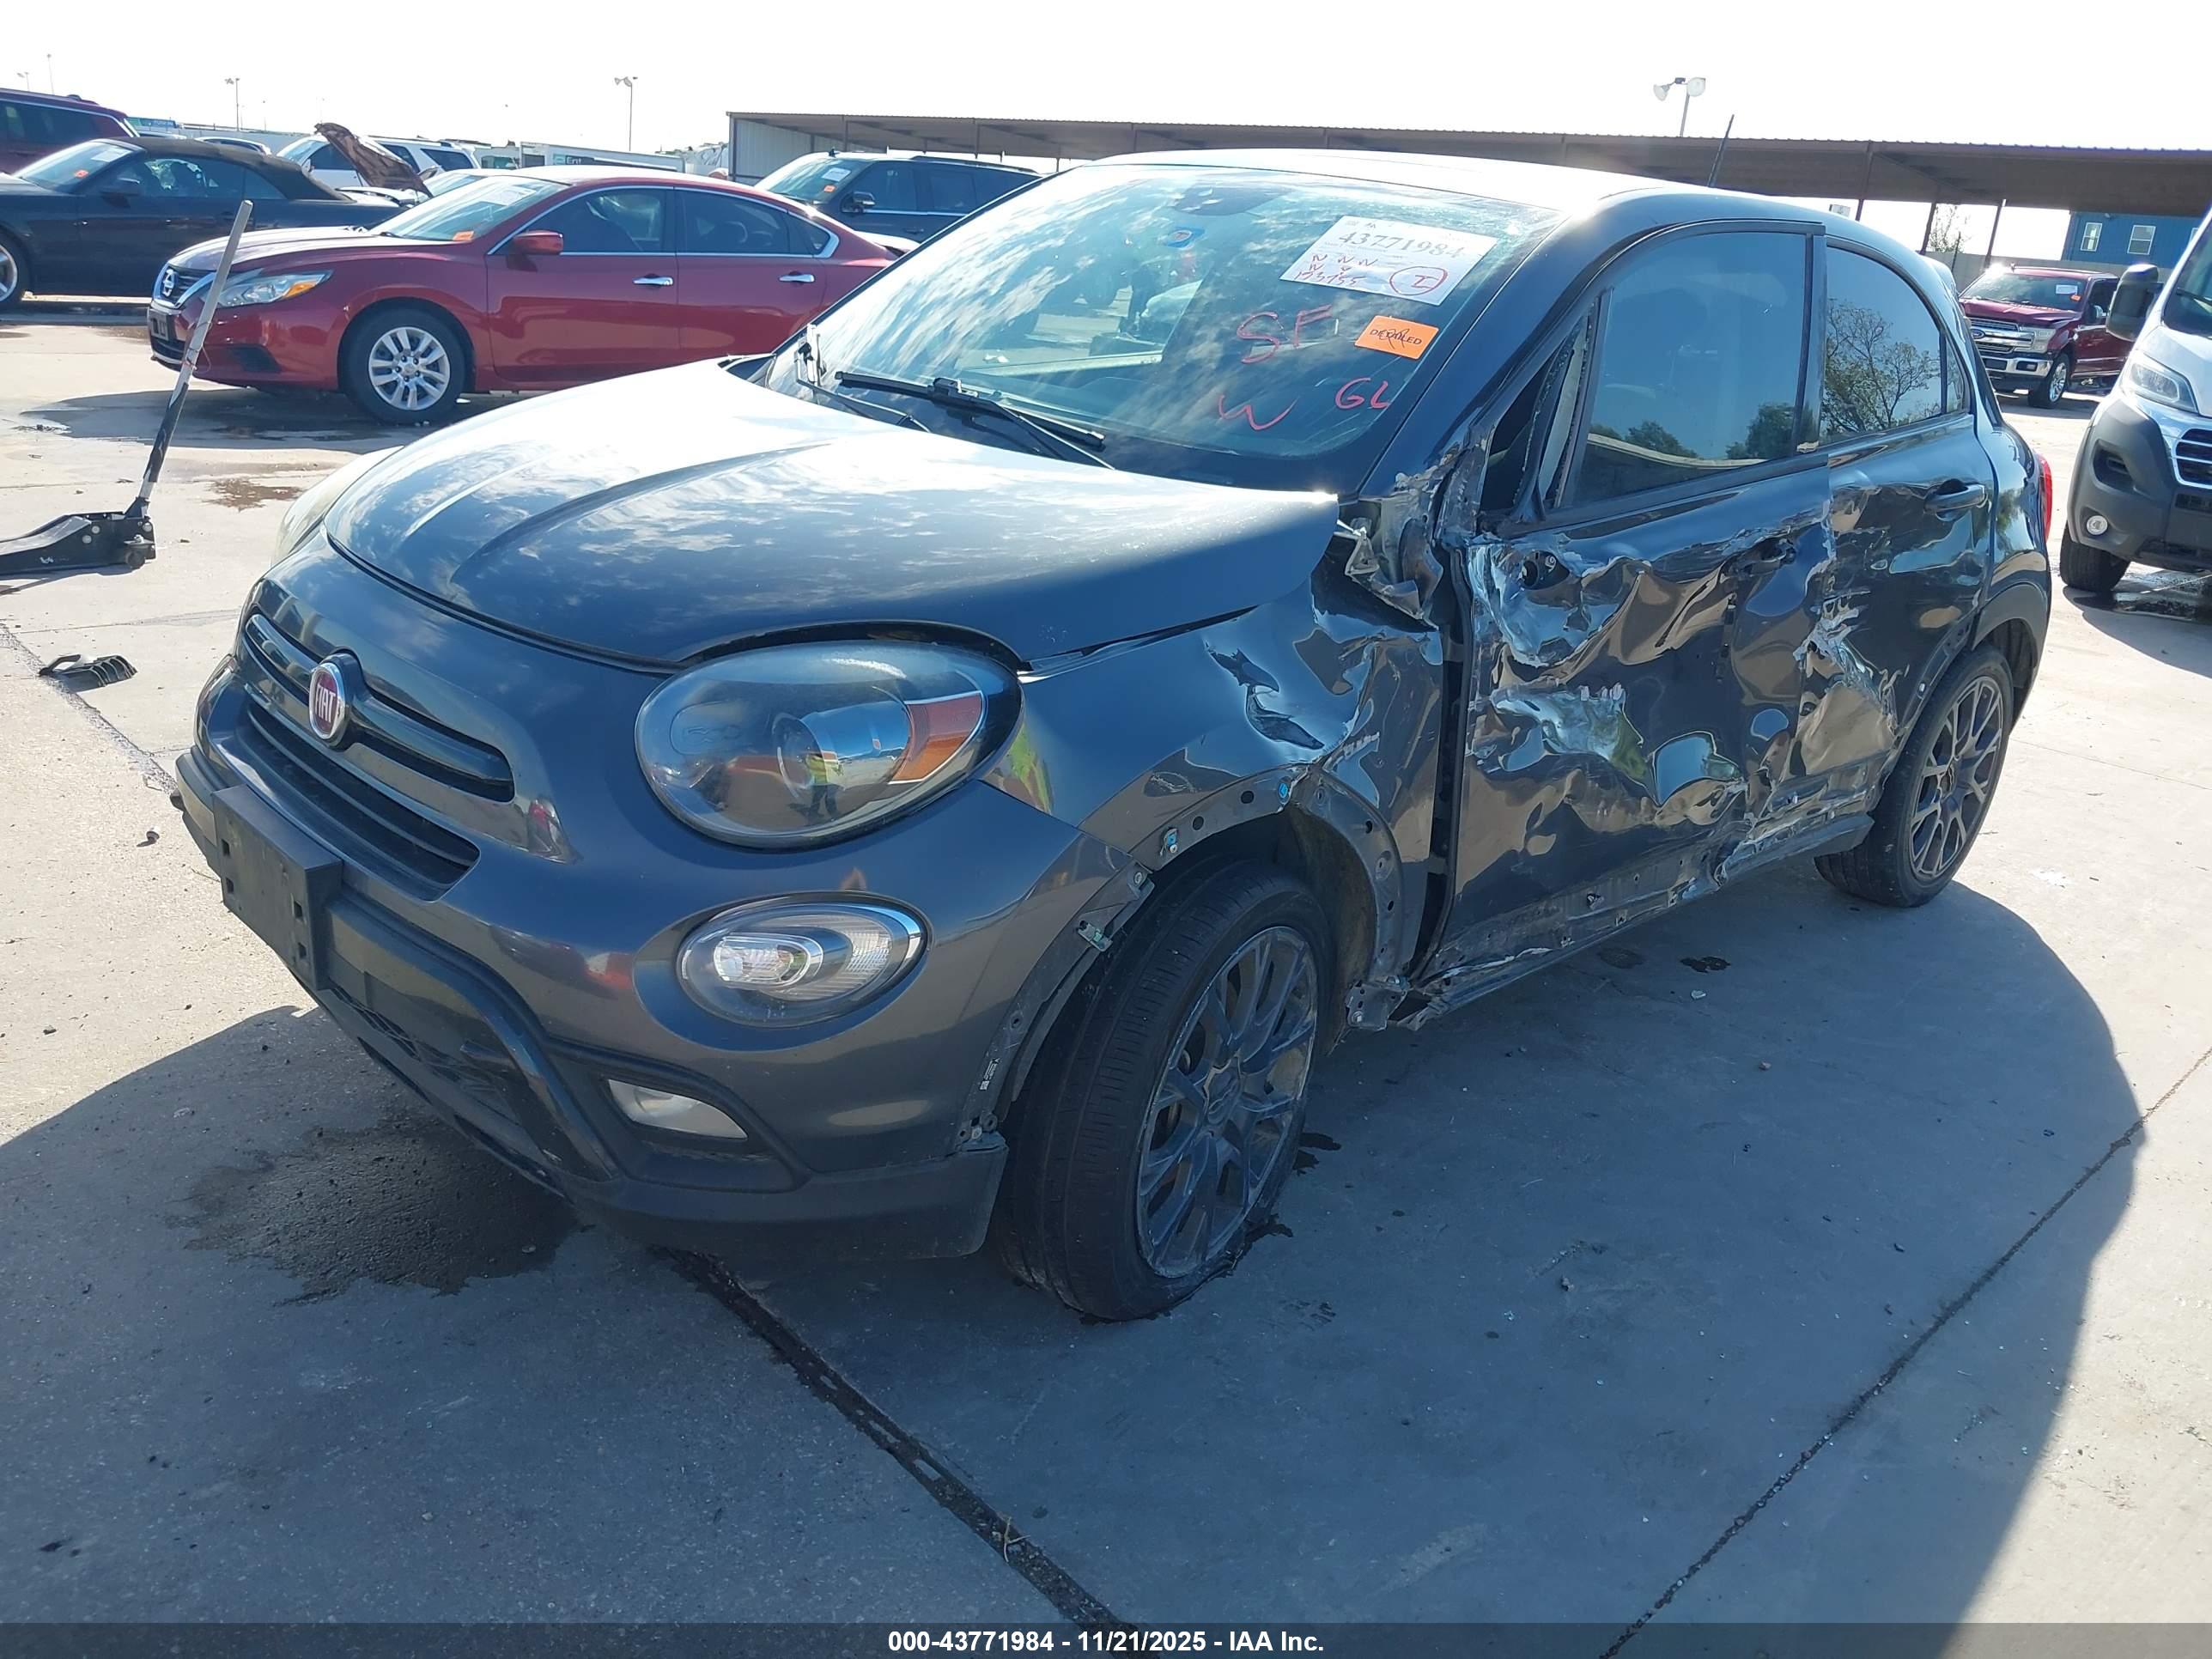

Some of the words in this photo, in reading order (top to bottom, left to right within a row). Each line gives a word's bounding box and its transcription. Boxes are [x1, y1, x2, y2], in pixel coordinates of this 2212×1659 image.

[1339, 231, 1465, 258] 43771984
[1237, 304, 1333, 364] SF
[314, 683, 337, 723] FIAT
